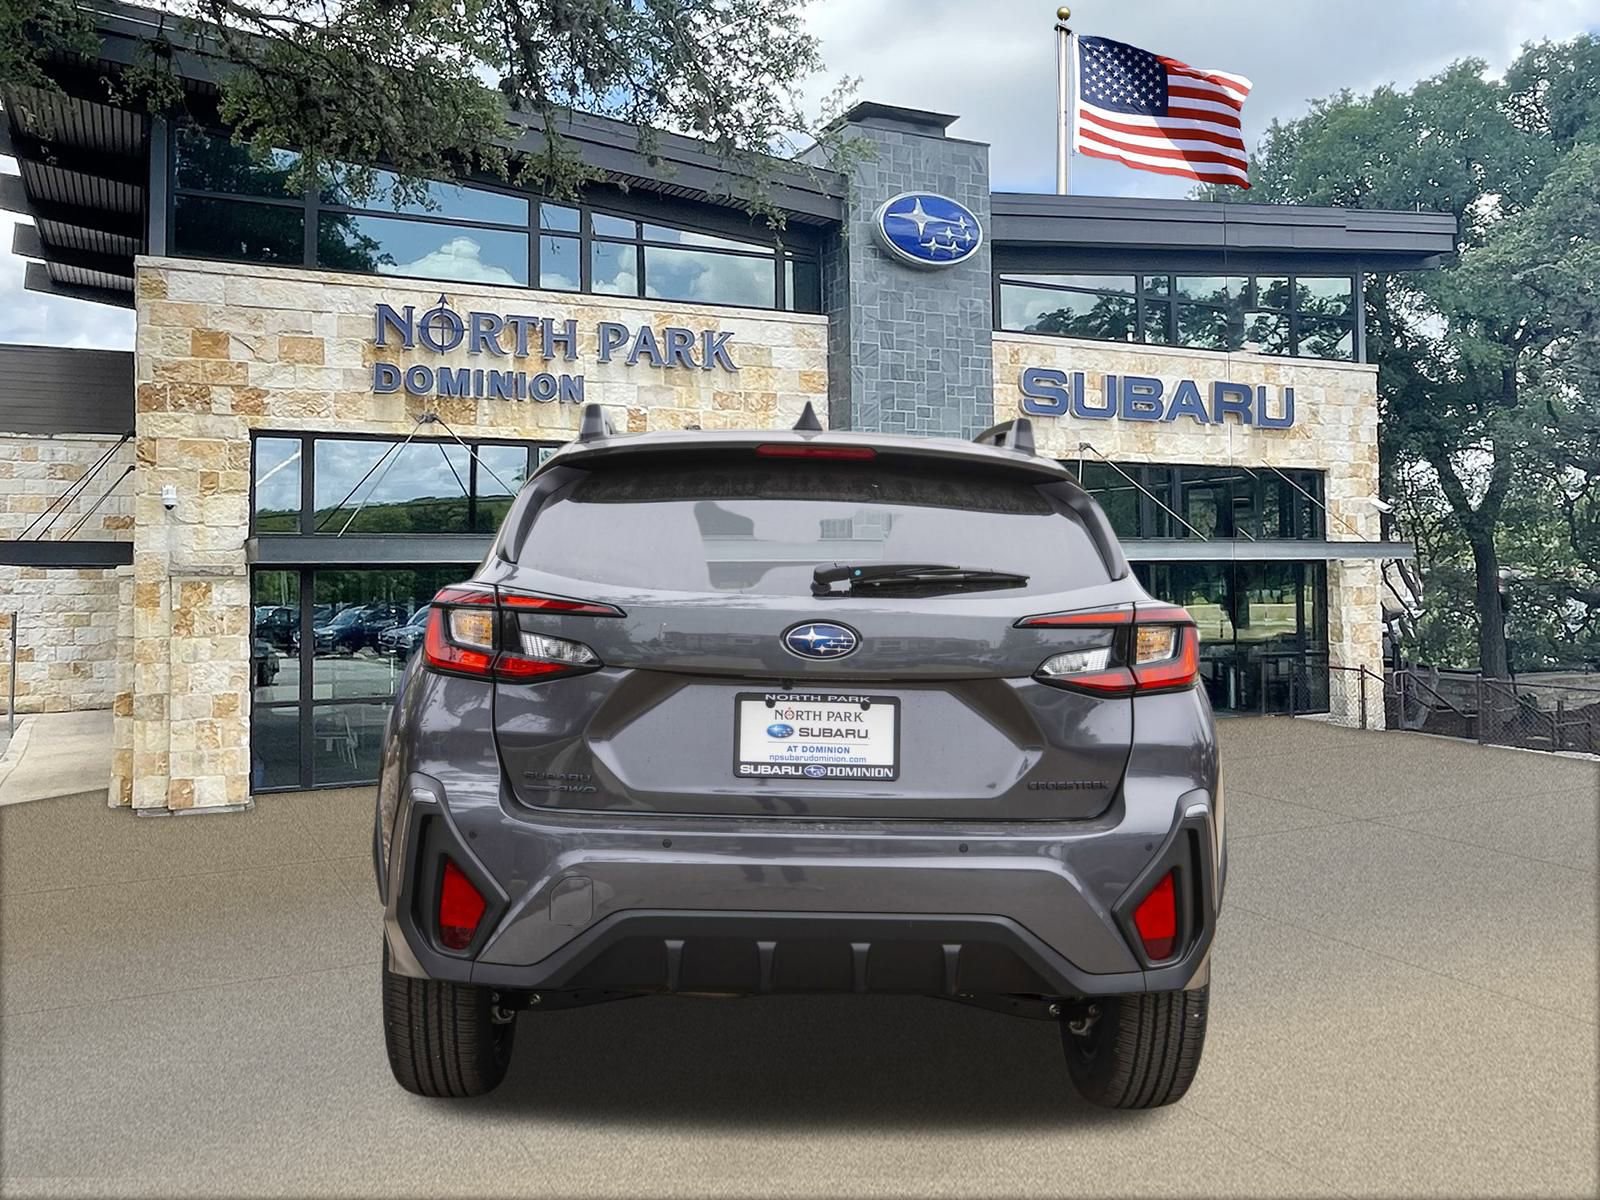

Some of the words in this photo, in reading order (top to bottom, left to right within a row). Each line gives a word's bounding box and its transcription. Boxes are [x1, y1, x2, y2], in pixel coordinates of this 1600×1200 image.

[374, 296, 579, 361] NORTH
[597, 321, 742, 373] PARK
[373, 362, 586, 405] DOMINION
[1018, 367, 1296, 430] SUBARU
[765, 693, 821, 702] NORTH
[827, 695, 871, 703] PARK
[774, 708, 822, 721] NORTH
[826, 711, 864, 723] PARK
[798, 727, 869, 739] SUBARU
[786, 745, 799, 753] AT
[801, 746, 850, 754] DOMINION
[769, 754, 867, 763] npsubarudominion.com
[740, 765, 802, 775] SUBARU
[827, 767, 893, 777] DOMINION
